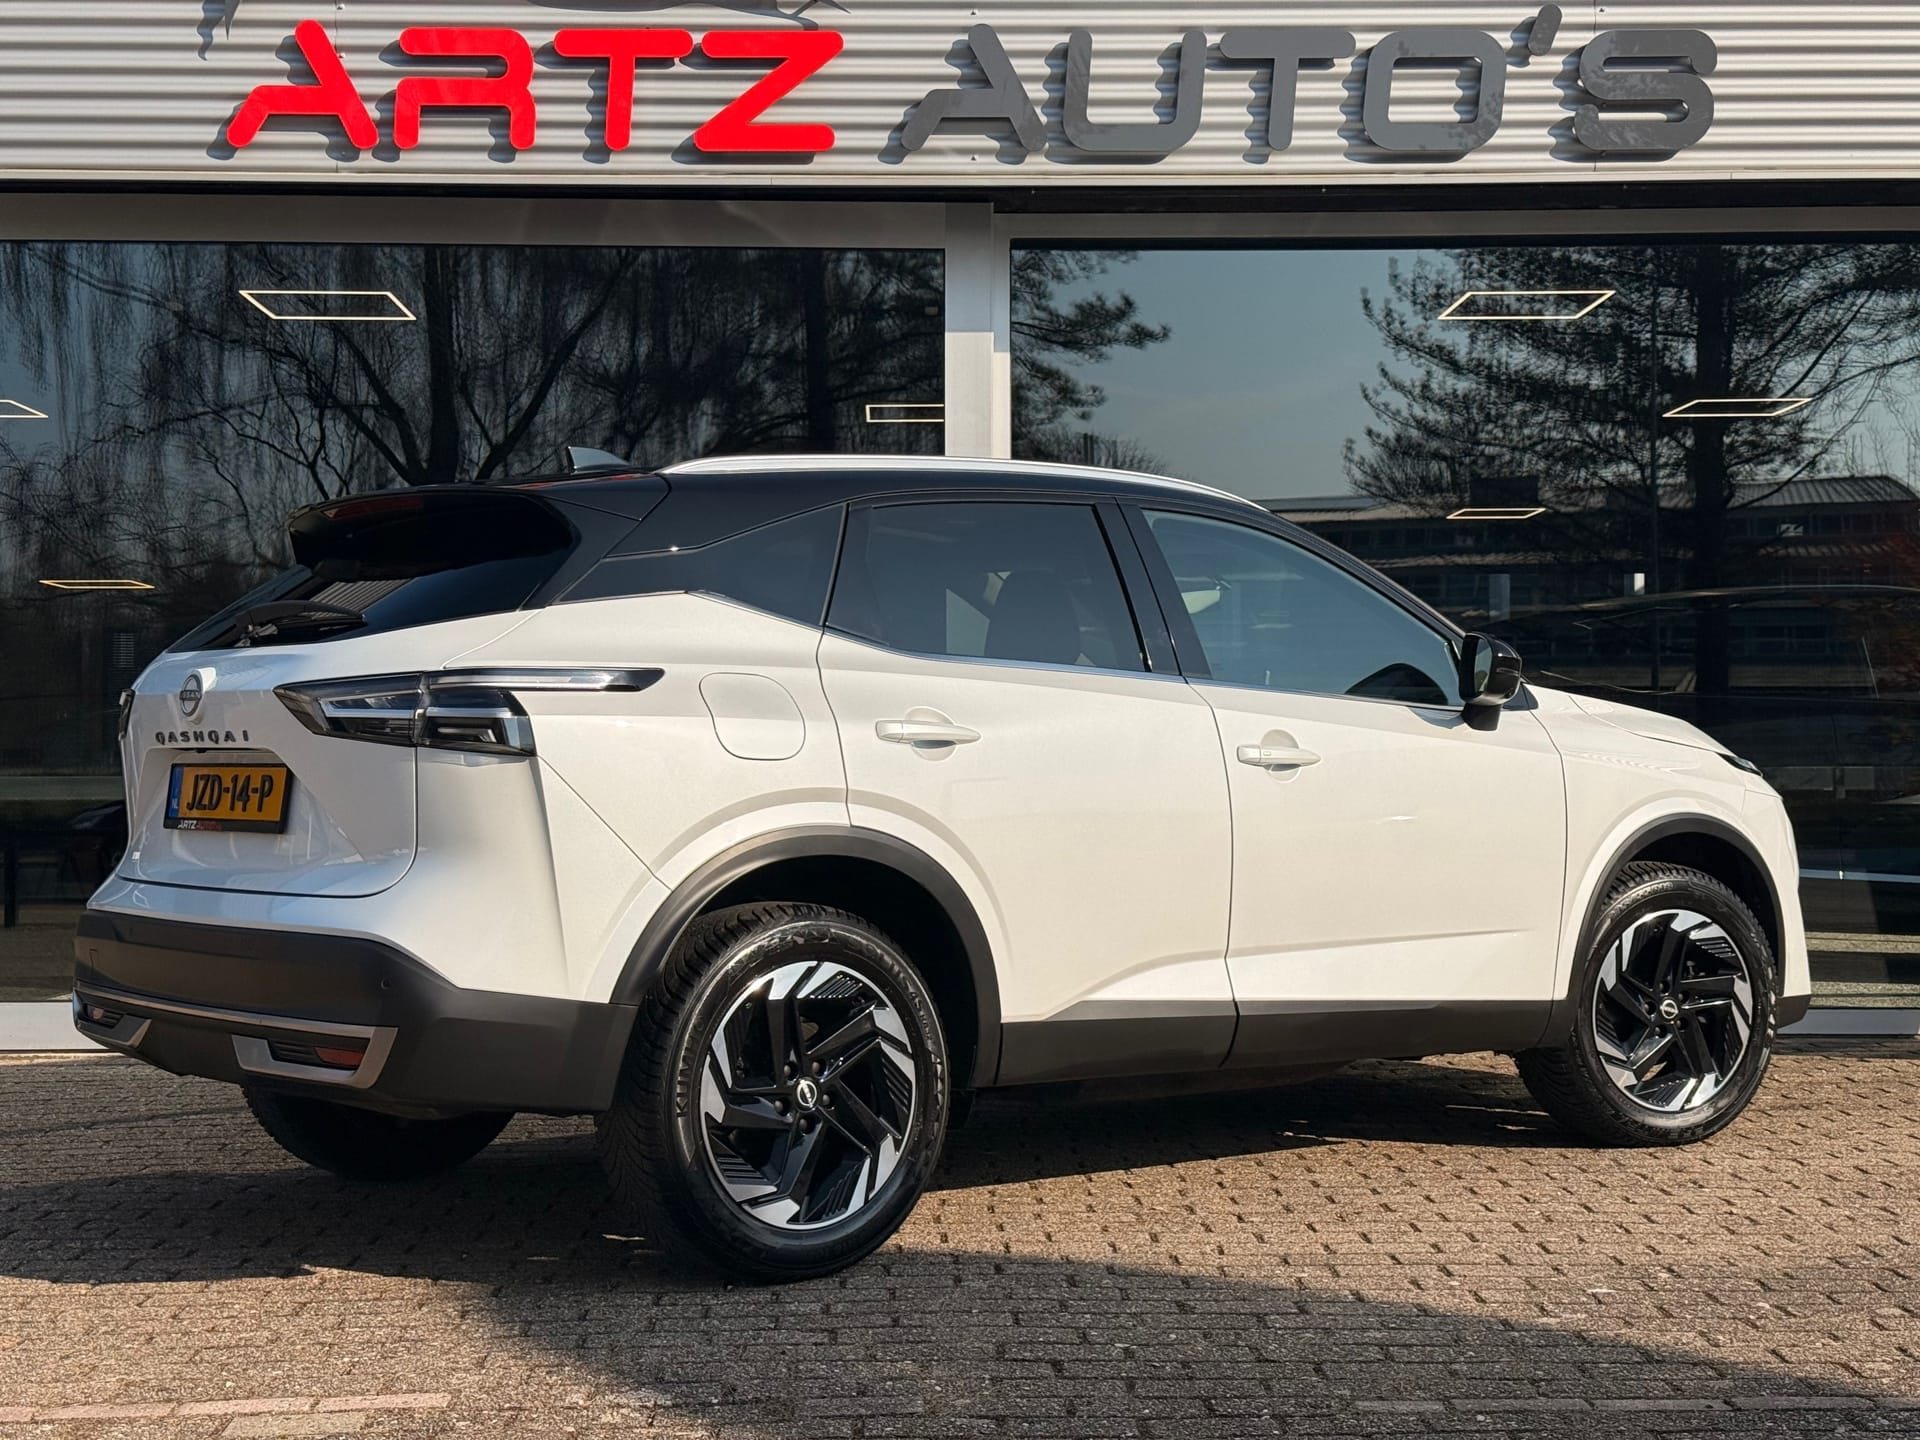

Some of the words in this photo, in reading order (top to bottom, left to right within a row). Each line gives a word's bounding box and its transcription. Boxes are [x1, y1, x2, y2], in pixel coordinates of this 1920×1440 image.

[227, 19, 844, 152] ARTZ
[900, 3, 1719, 153] AUTO'S
[155, 730, 250, 745] QASHQAI
[171, 798, 179, 809] NL
[186, 774, 273, 812] JZD-14-P
